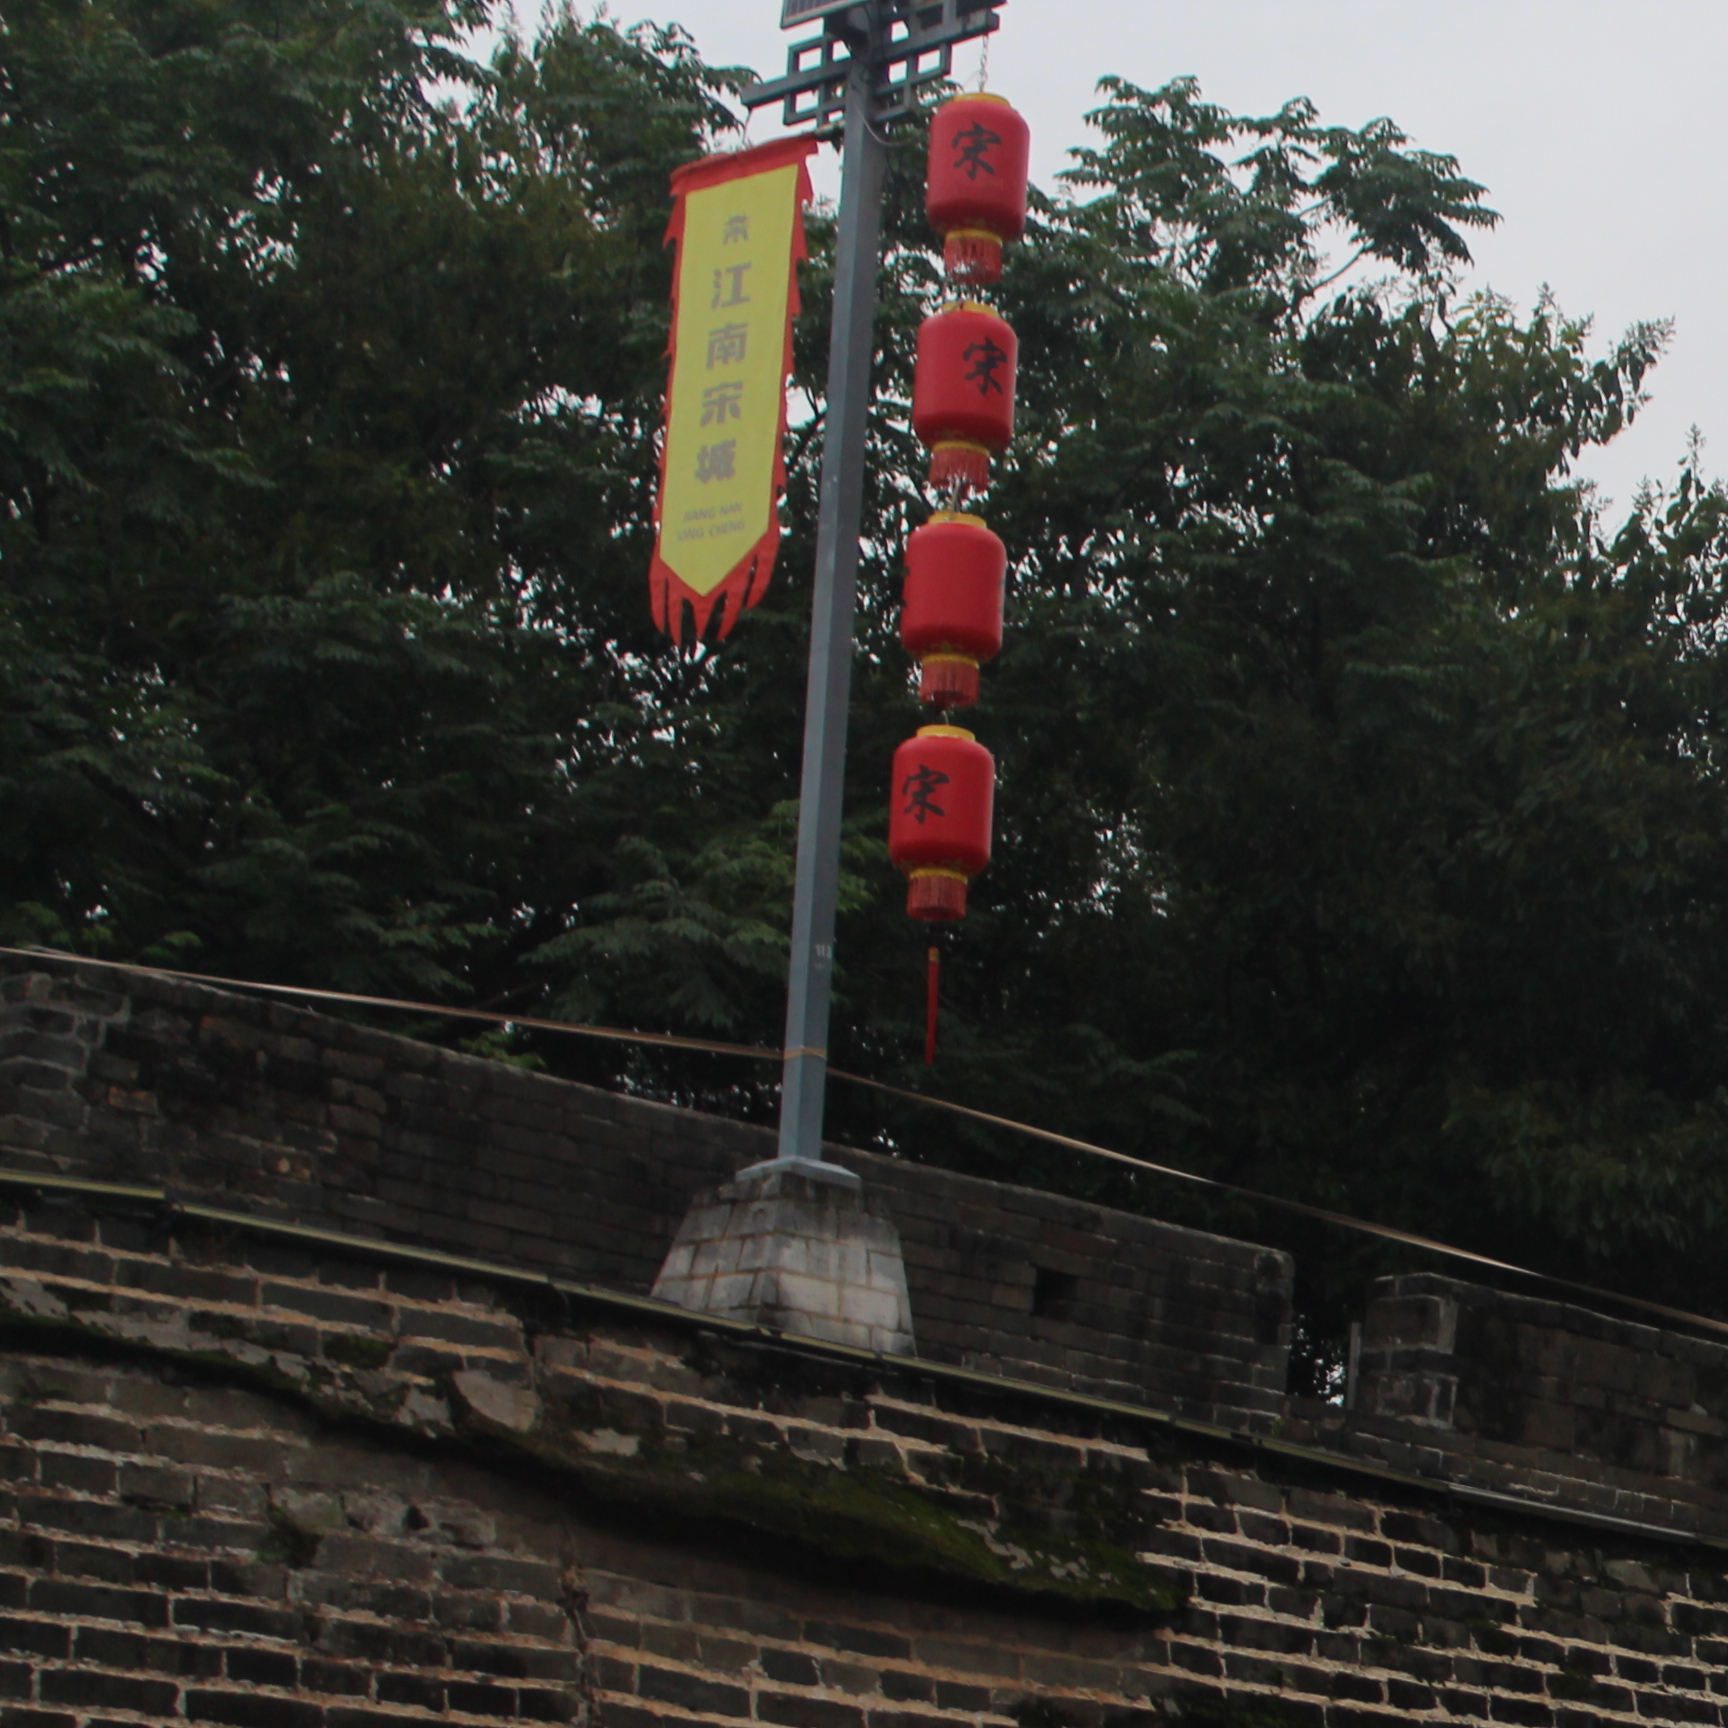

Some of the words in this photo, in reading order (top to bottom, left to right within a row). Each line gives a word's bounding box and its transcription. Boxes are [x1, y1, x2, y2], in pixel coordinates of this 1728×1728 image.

[950, 122, 1001, 181] 宋
[694, 260, 752, 484] 江南宋城
[962, 337, 1008, 397] 宋
[901, 765, 952, 824] 宋
